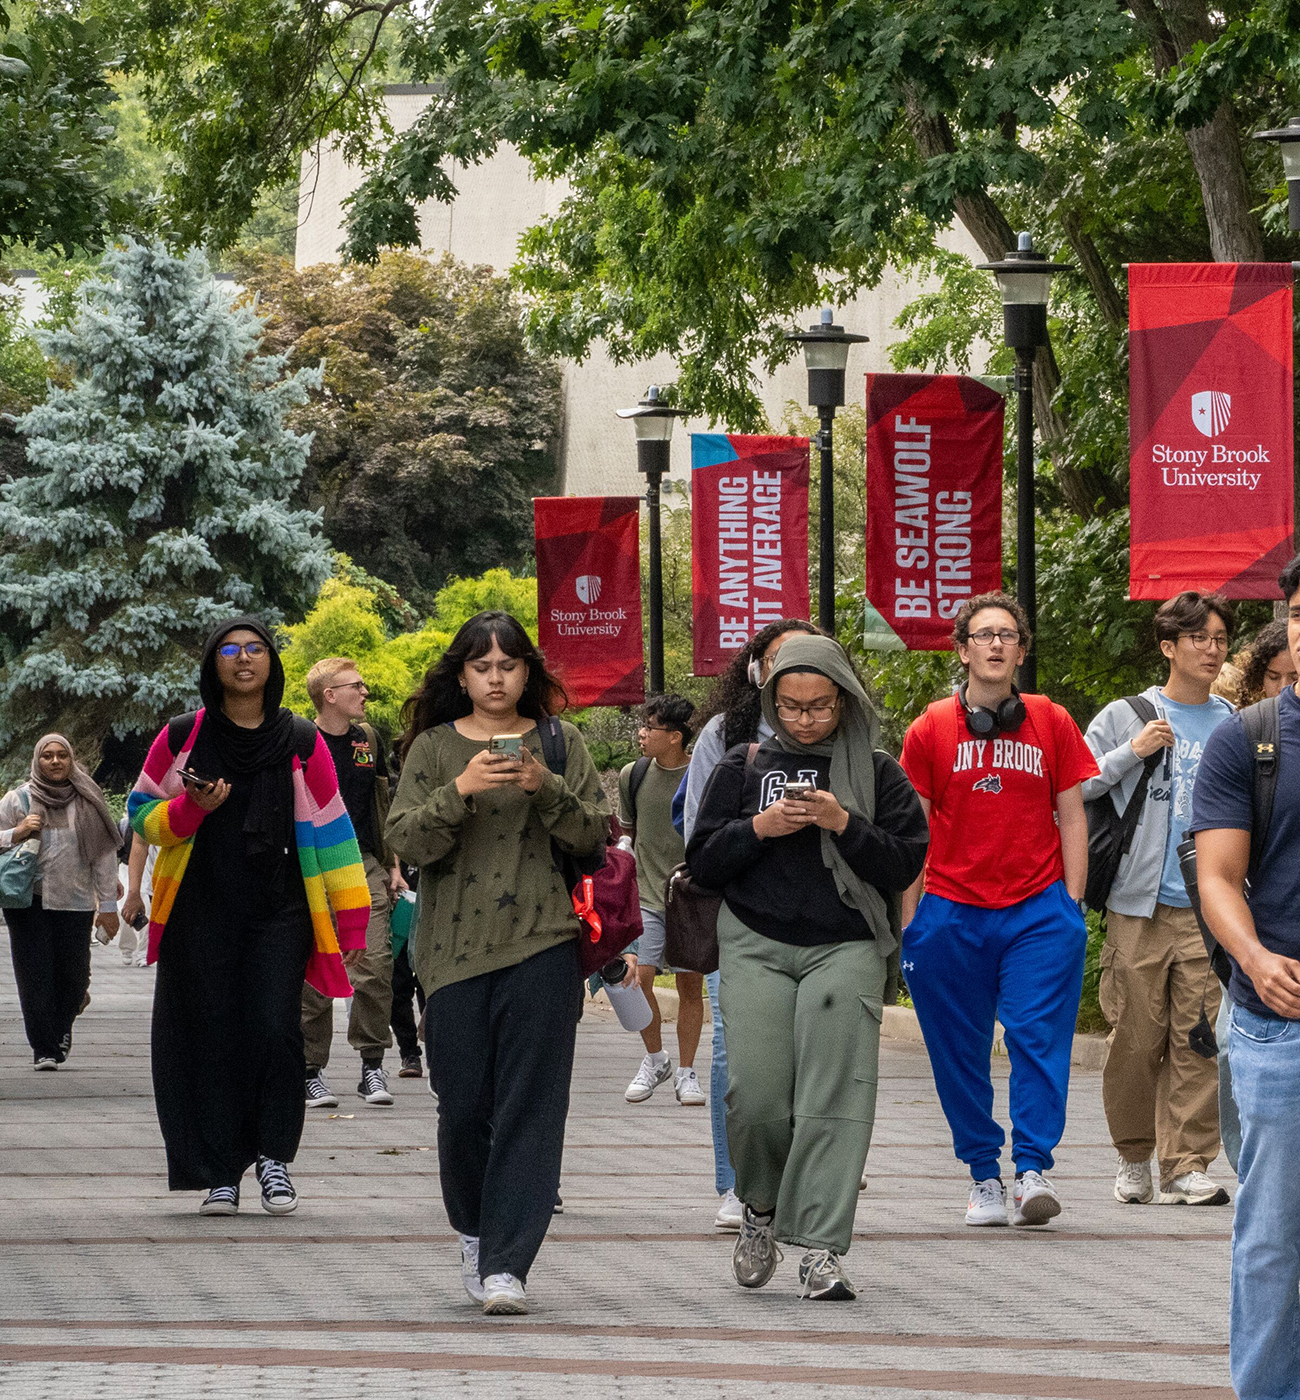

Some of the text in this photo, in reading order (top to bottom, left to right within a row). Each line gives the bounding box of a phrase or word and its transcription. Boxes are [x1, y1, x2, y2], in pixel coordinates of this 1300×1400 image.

[1152, 444, 1271, 467] Stony Brook
[1161, 467, 1262, 491] University
[894, 415, 932, 618] BE SEAWOLF
[719, 477, 749, 649] BE ANYTHING
[753, 470, 783, 632] UT AVERAGE
[935, 491, 972, 620] STRONG
[550, 607, 628, 623] Stony Brook
[557, 622, 622, 637] University
[992, 738, 1044, 778] BROOK
